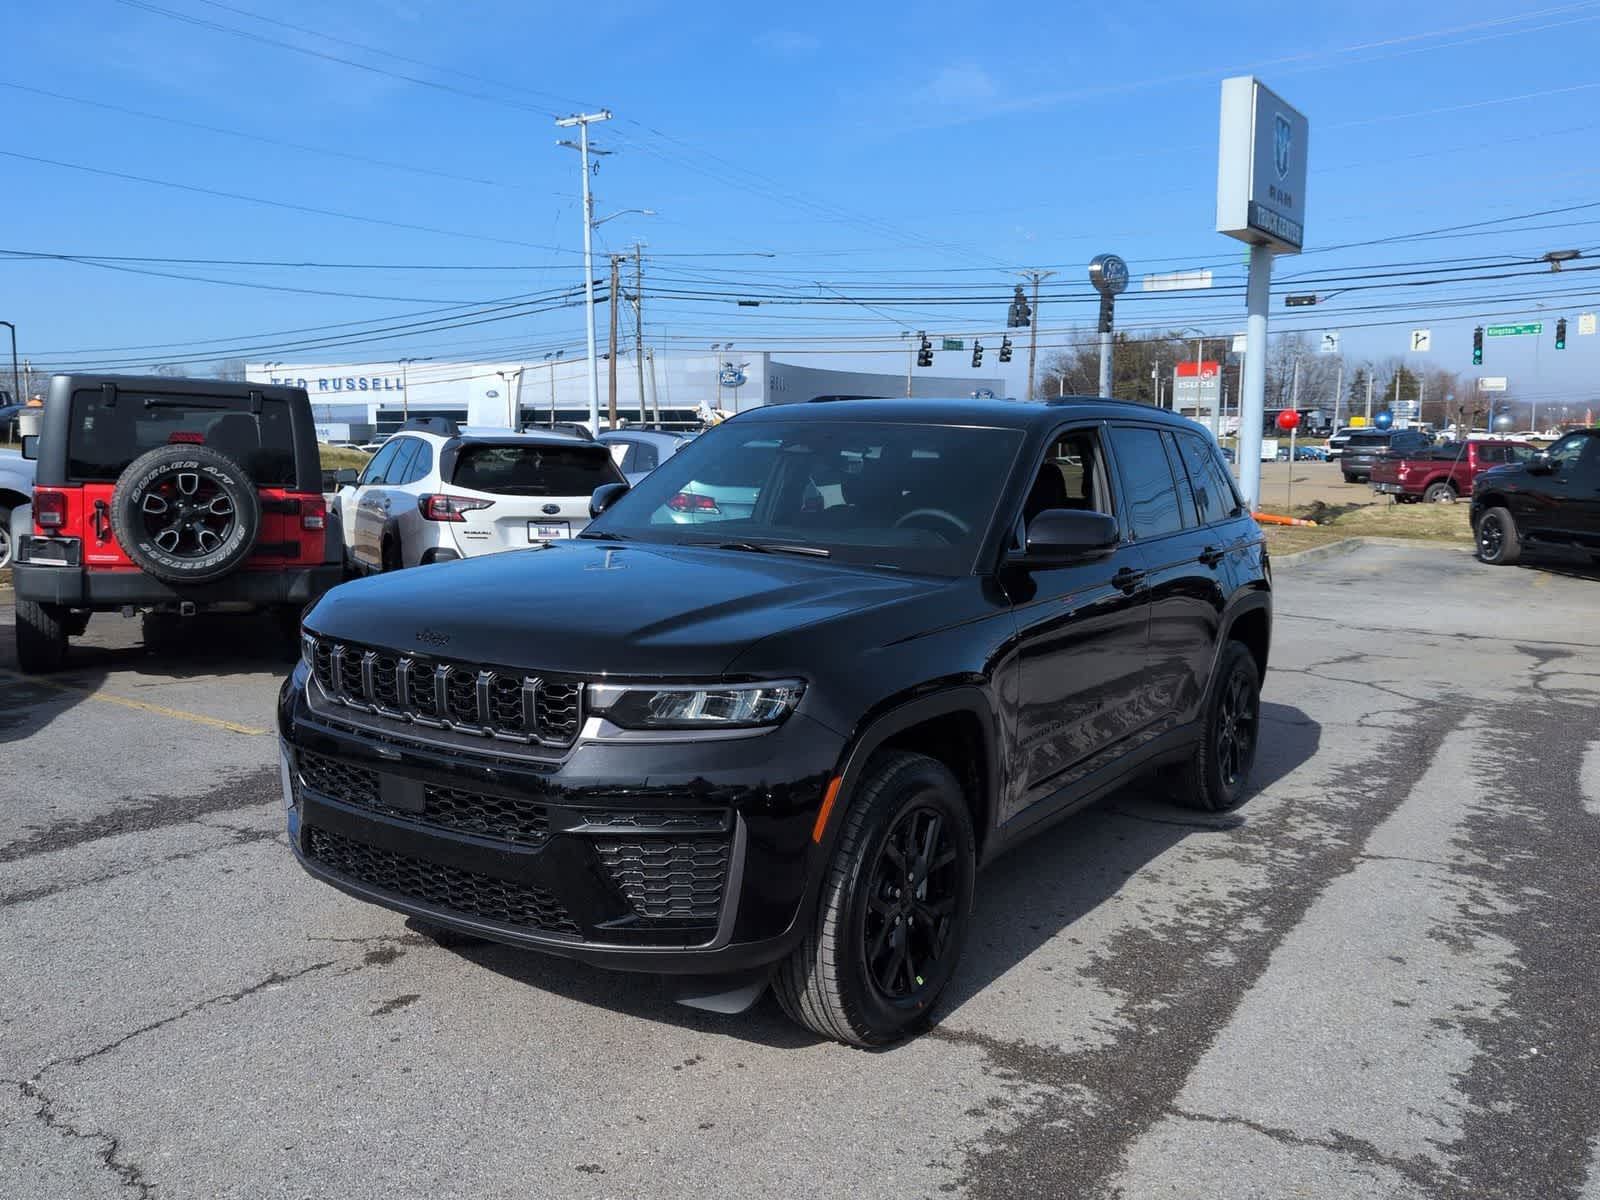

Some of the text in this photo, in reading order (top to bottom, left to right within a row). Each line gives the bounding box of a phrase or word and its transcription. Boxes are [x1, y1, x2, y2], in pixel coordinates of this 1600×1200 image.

[1269, 184, 1292, 208] RAM
[271, 377, 405, 391] TED RUSSELL
